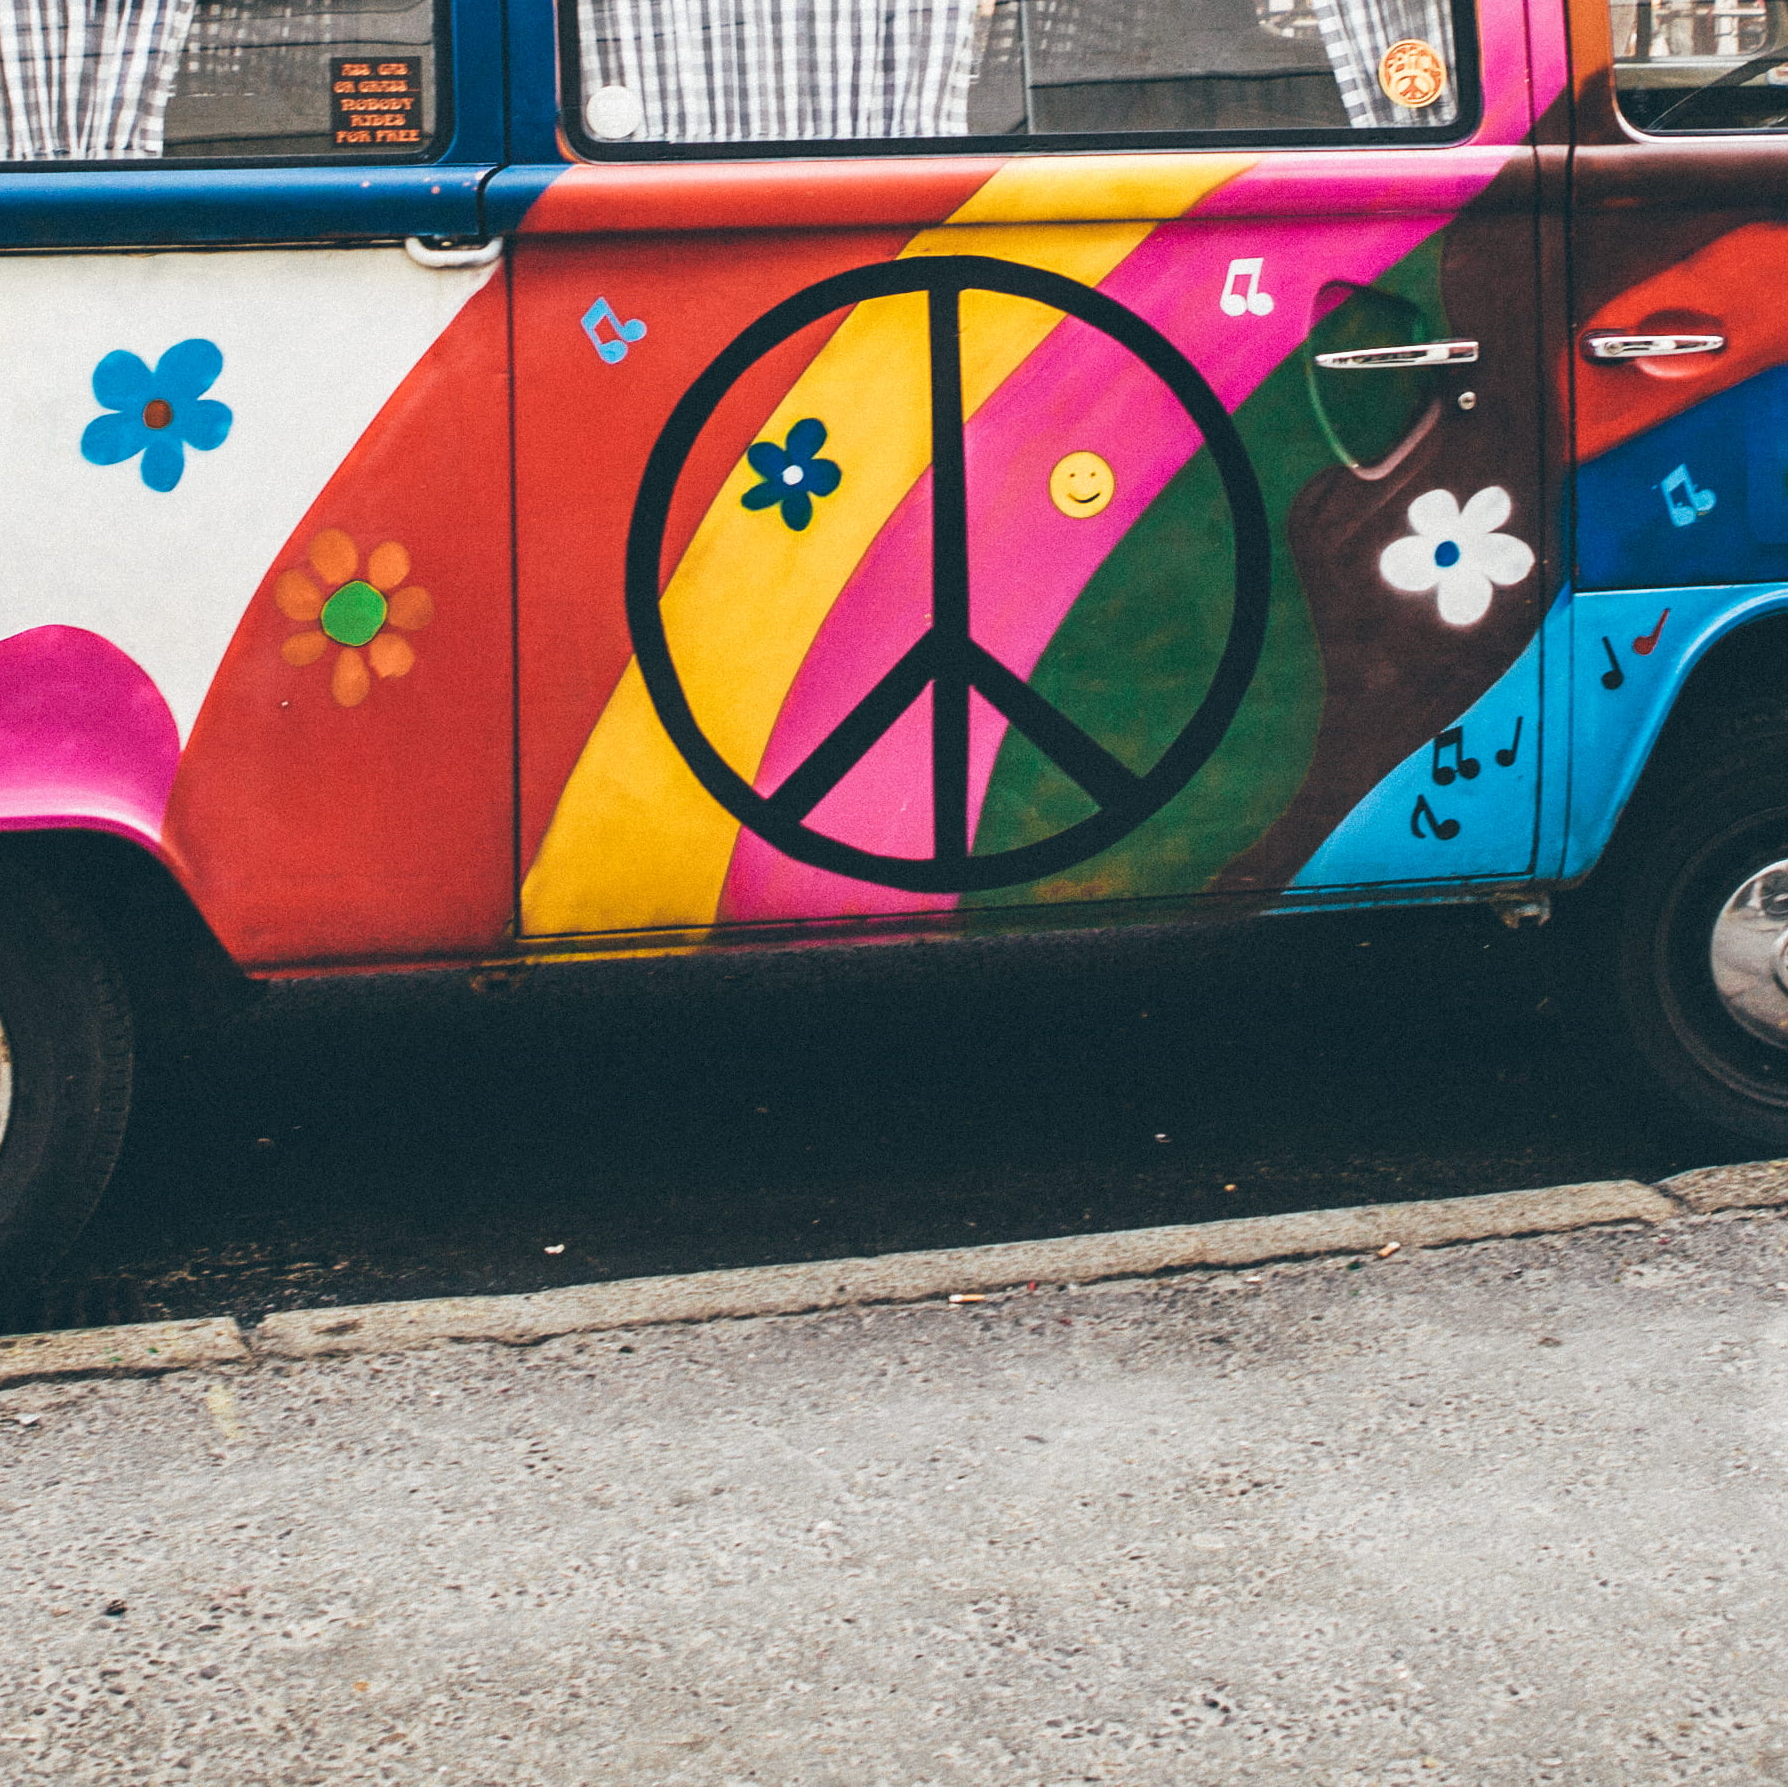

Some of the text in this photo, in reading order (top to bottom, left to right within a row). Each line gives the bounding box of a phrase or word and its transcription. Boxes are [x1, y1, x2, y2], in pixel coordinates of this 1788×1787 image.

[340, 97, 415, 111] NOBODY
[350, 113, 407, 127] RIDES
[336, 129, 421, 143] FOR FREE
